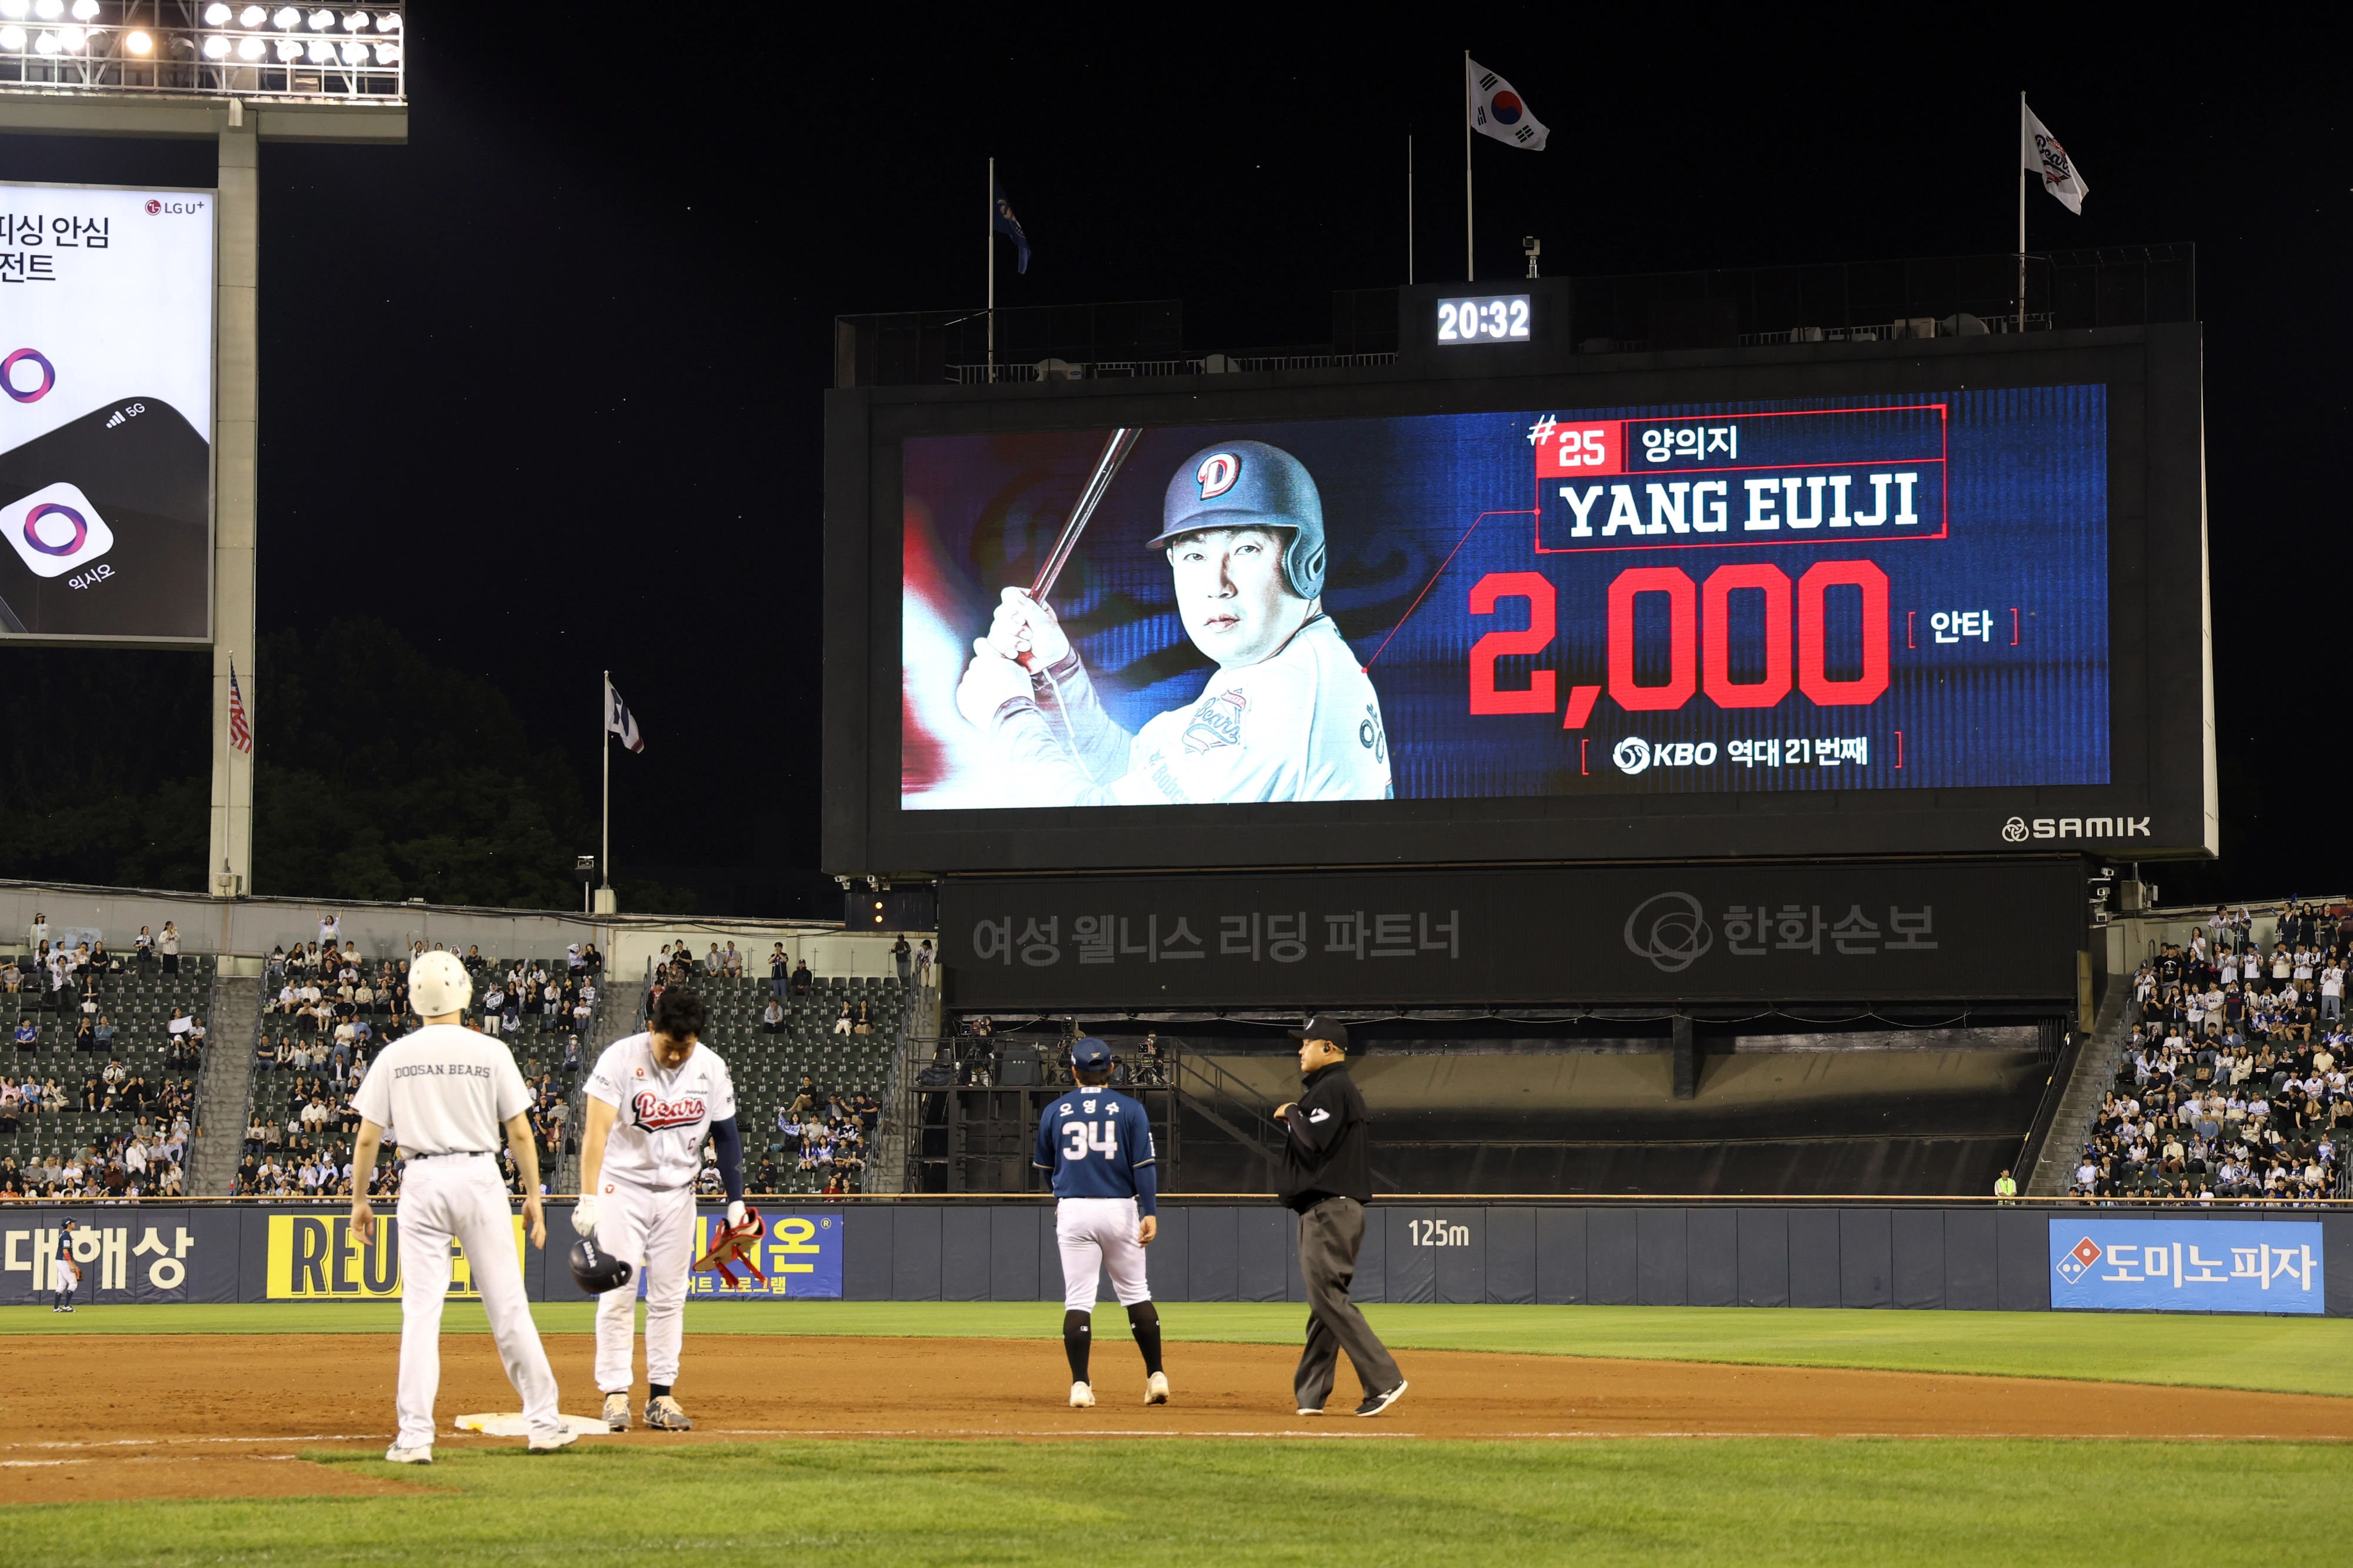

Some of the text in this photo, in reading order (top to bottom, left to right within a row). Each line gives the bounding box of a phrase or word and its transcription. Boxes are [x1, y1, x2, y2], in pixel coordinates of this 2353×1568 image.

[52, 216, 108, 248] 안심
[0, 252, 56, 283] 전트
[1438, 300, 1528, 340] 20:32
[125, 403, 145, 417] 5G
[1642, 425, 1737, 462] 양의지
[1559, 472, 1918, 537] YANG EUIJI
[68, 563, 115, 590] 익시오
[1930, 610, 1993, 643] 안타
[1469, 559, 1889, 729] 2,000
[1654, 736, 1868, 768] KBO 역대 21 번째
[2033, 817, 2150, 838] SAMIK
[972, 910, 1459, 967] 여성 웰니스 리딩 파트너
[1722, 905, 1938, 955] 한화손보
[394, 1064, 491, 1079] DOOSAN BEARS
[633, 1090, 706, 1126] Bears
[1060, 1099, 1119, 1117] 오영수
[1062, 1120, 1118, 1160] 34
[1408, 1220, 1469, 1246] 125m
[5, 1226, 194, 1290] 대해상
[2101, 1242, 2317, 1290] 도미노피자
